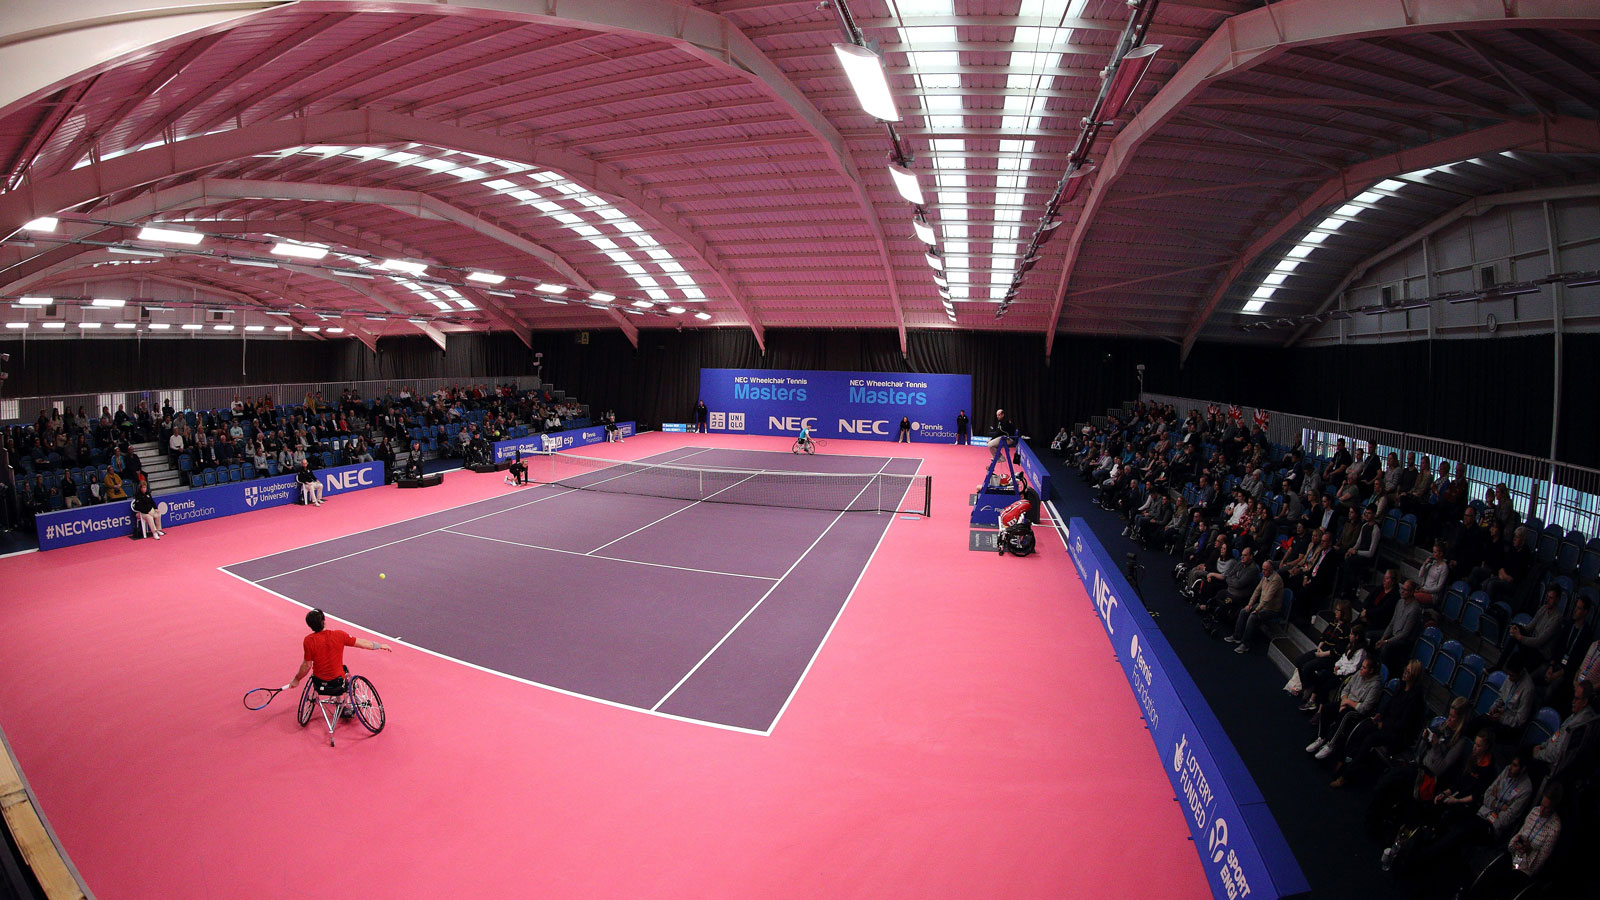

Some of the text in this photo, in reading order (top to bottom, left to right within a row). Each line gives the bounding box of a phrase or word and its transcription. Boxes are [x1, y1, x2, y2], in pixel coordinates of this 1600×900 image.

[734, 384, 807, 401] Masters
[850, 386, 927, 405] Masters
[769, 416, 818, 431] NEC
[838, 419, 889, 434] NEC
[564, 436, 573, 446] esp
[260, 482, 298, 493] Loughboroug
[326, 467, 373, 491] NEC
[169, 500, 196, 511] Tennis
[260, 491, 289, 502] University
[170, 506, 215, 522] Foundation
[46, 515, 131, 539] #NECMasters
[1092, 569, 1118, 635] NEC
[1136, 646, 1152, 686] Tennis
[1132, 664, 1159, 730] Foundation
[1186, 749, 1214, 808] LOTTERY
[1180, 770, 1206, 829] FUNDED
[1227, 849, 1251, 898] SPORT
